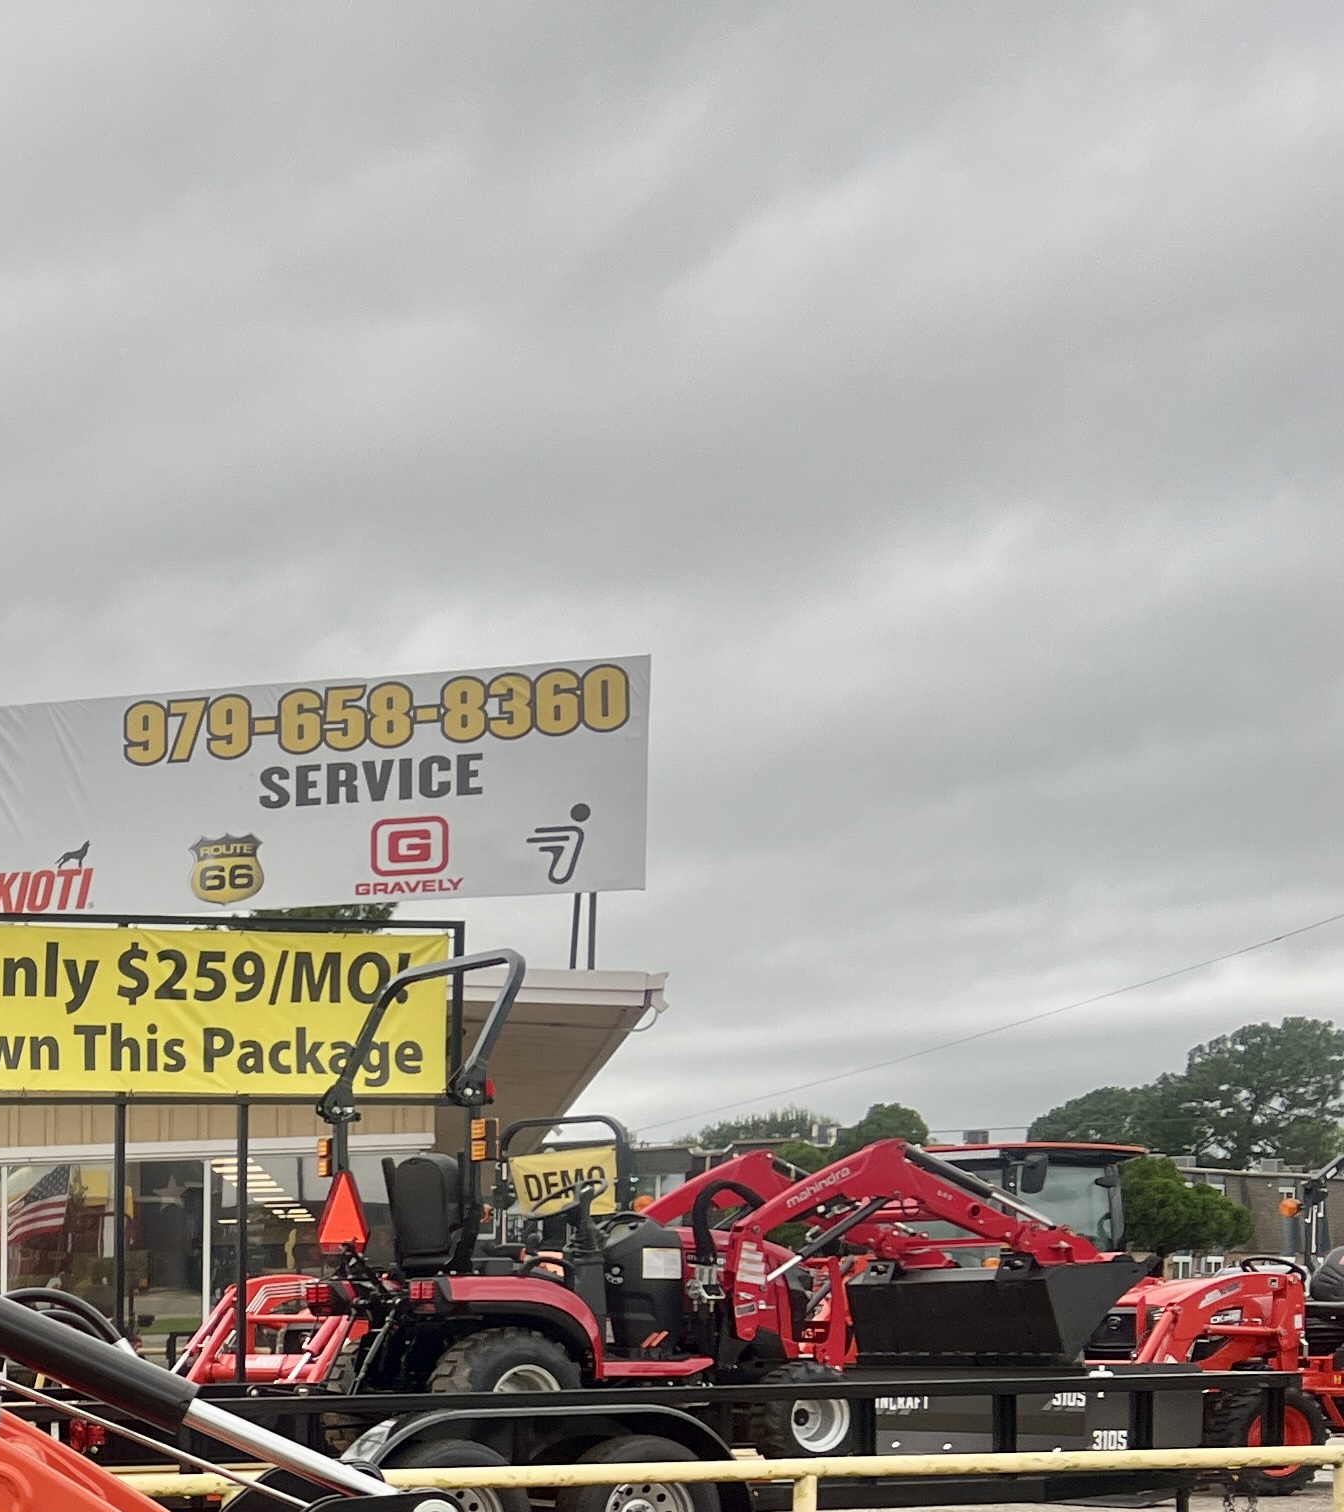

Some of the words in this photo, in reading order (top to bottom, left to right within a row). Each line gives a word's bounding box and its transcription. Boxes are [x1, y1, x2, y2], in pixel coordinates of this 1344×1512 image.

[123, 663, 630, 767] 979-658-8360
[259, 752, 483, 809] SERVICE
[199, 842, 253, 858] ROUTE
[199, 864, 255, 891] 66
[354, 878, 465, 896] GRAVELY
[116, 942, 412, 1006] $259/MO!
[73, 1022, 187, 1074] This
[202, 1026, 423, 1087] Package
[522, 1165, 607, 1204] DEMO
[786, 1166, 852, 1208] mahindra
